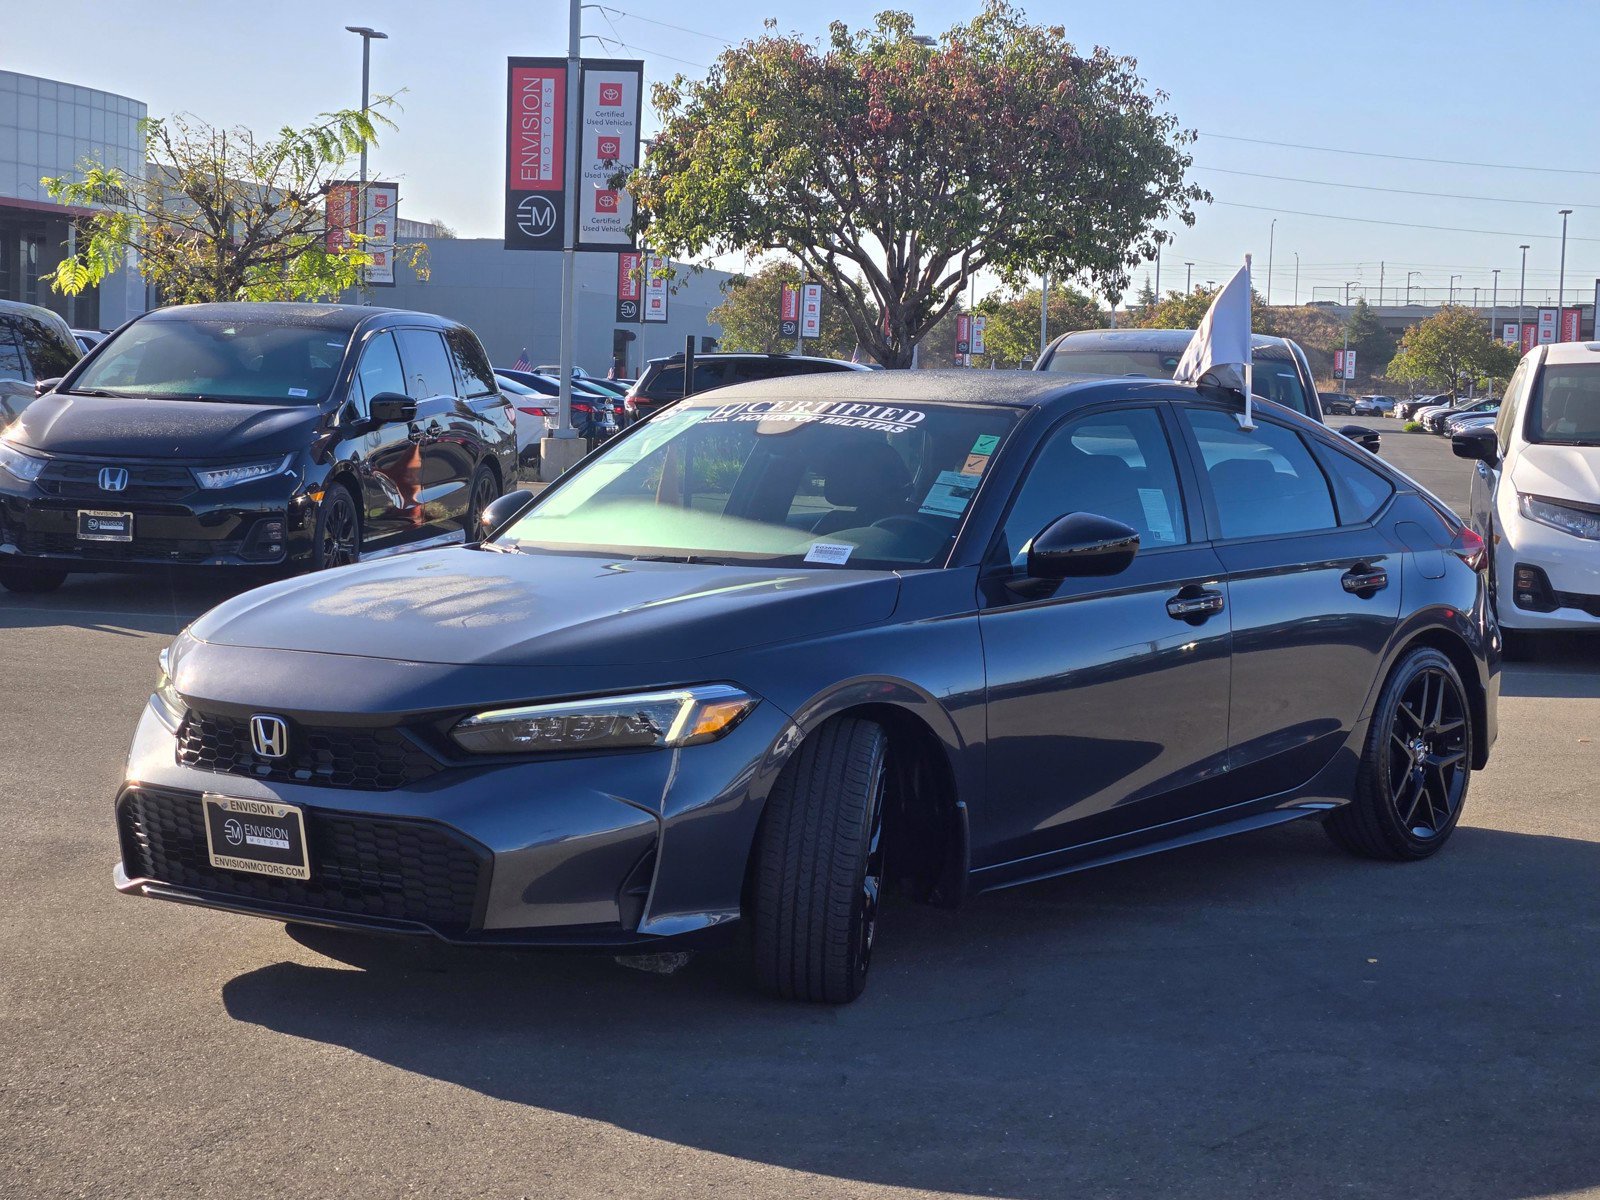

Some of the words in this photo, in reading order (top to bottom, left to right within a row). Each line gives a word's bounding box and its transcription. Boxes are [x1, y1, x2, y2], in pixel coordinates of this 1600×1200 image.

[586, 118, 604, 126] Used
[605, 119, 633, 127] Vehicles
[595, 110, 625, 118] Certified
[521, 77, 541, 181] ENVISION
[543, 87, 552, 172] MOTORS
[747, 400, 926, 424] CERTIFIED
[819, 417, 908, 434] MILPITAS
[230, 800, 275, 816] ENVISION
[244, 823, 289, 841] ENVISION
[249, 837, 287, 847] MOTORS
[214, 856, 306, 878] ENVISIONMOTORS.COM
